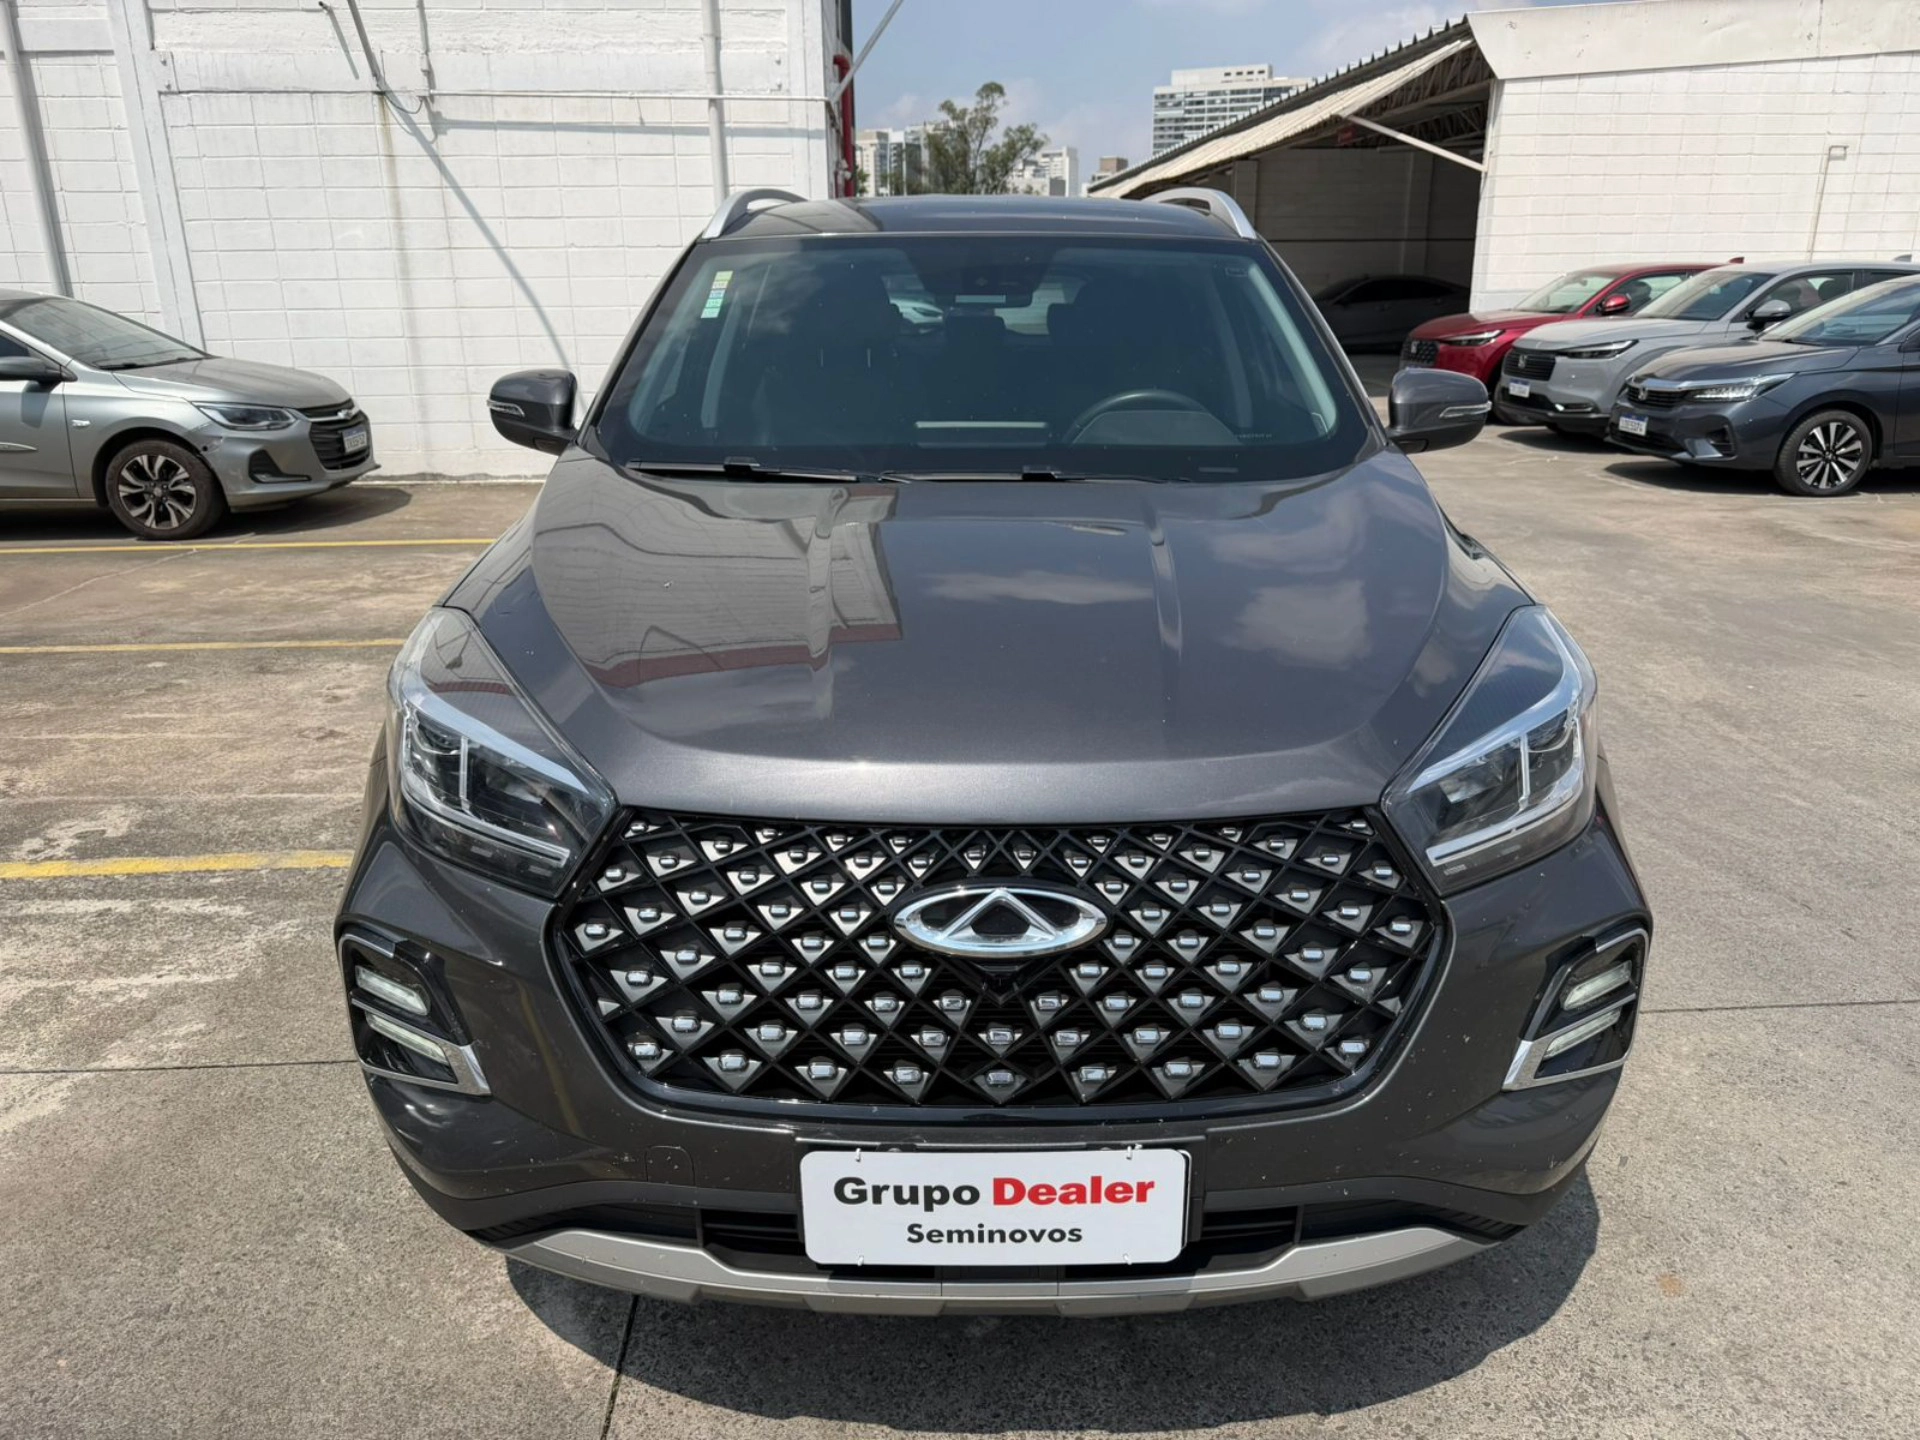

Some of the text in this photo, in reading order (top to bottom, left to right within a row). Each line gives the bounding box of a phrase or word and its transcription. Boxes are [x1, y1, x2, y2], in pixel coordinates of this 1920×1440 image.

[834, 1176, 1154, 1212] Grupo Dealer
[907, 1223, 1083, 1243] Seminovos
